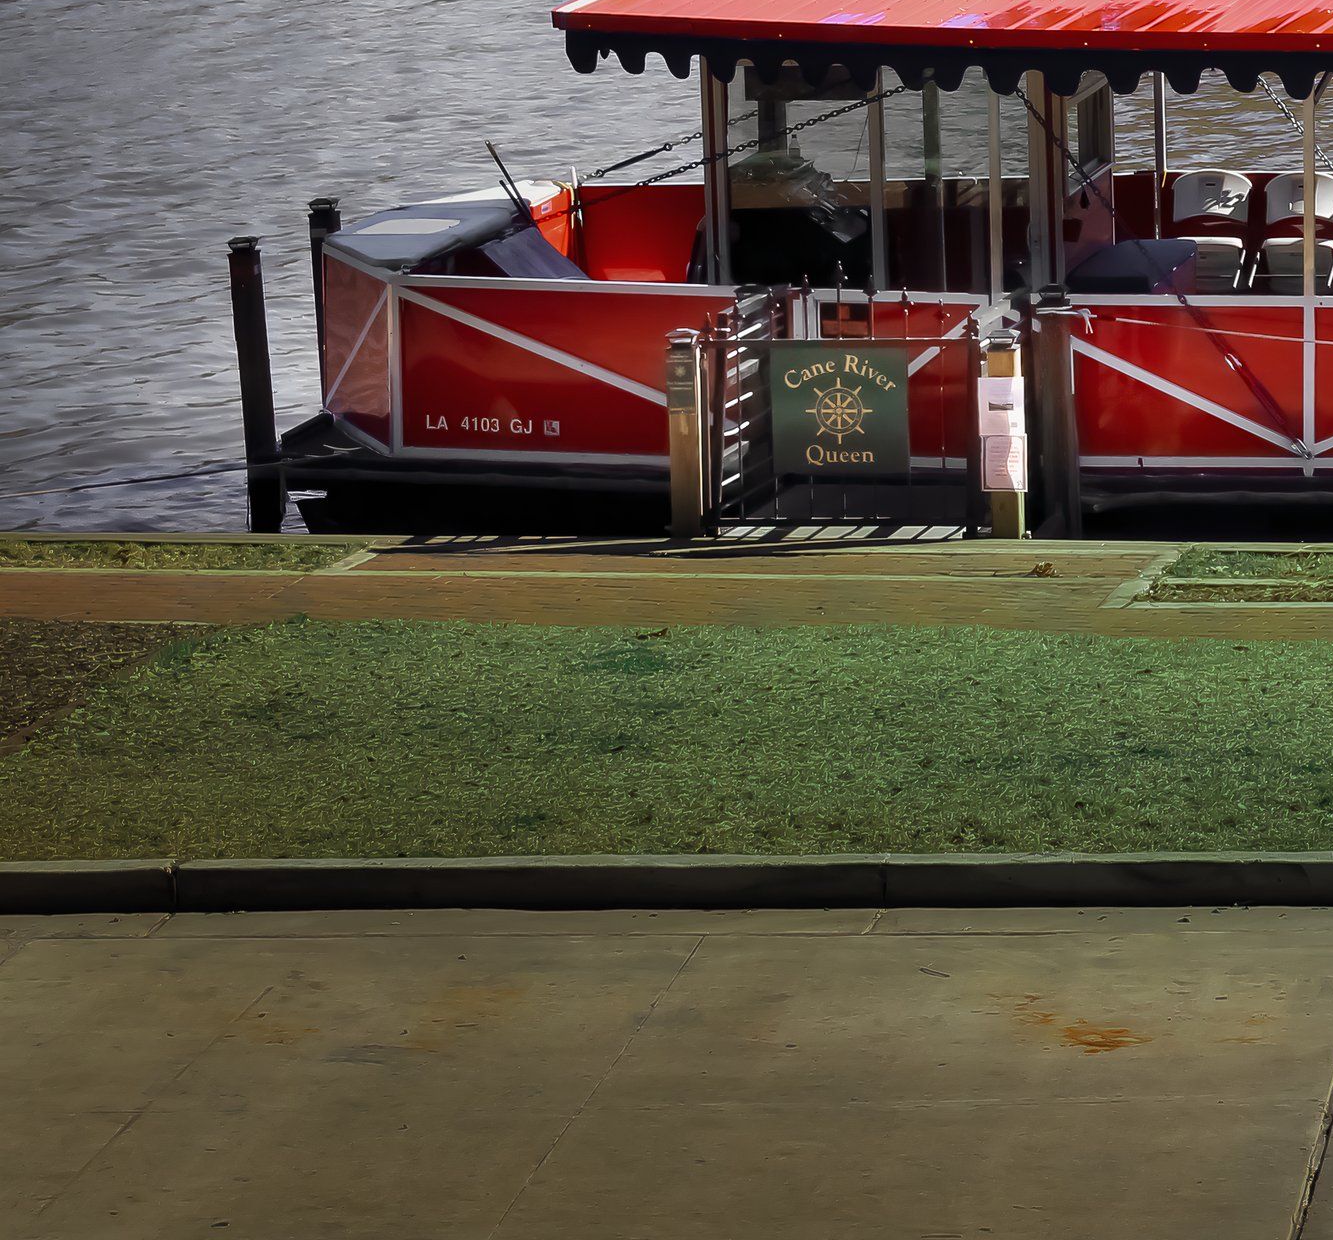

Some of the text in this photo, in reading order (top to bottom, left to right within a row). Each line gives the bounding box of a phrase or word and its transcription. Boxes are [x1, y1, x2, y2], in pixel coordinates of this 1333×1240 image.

[784, 354, 897, 392] Cane River
[425, 414, 533, 435] LA 4103 GJ
[806, 444, 875, 466] Queen
